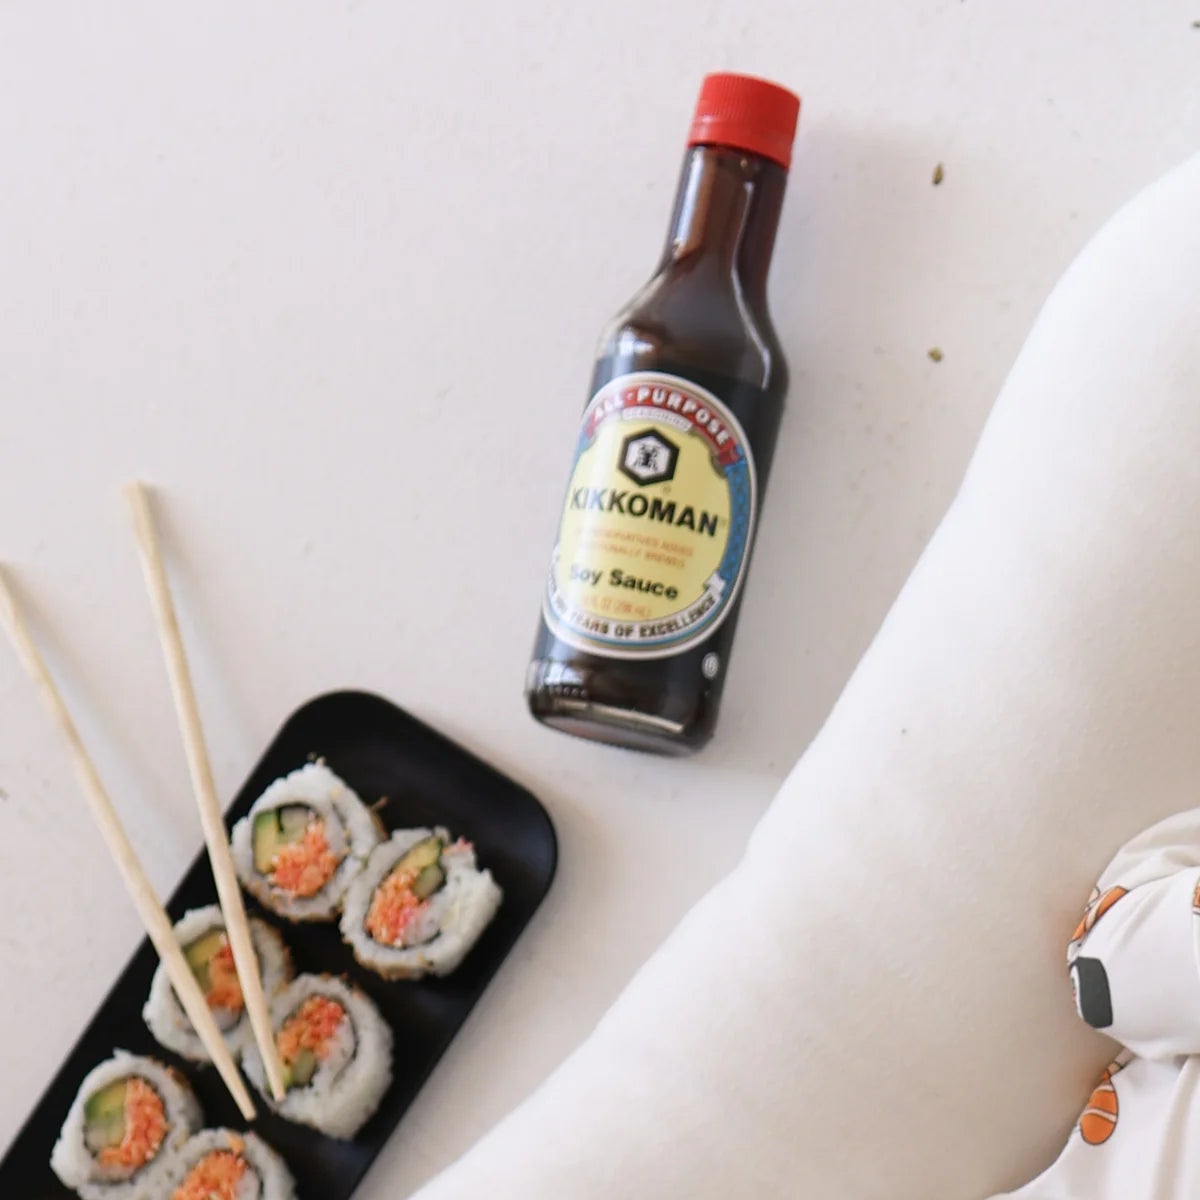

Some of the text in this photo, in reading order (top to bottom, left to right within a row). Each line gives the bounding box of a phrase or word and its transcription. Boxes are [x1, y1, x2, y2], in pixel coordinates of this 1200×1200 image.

[570, 487, 719, 537] KIKKOMAN
[570, 563, 679, 600] Soy Sauce
[614, 625, 634, 638] OF
[639, 594, 716, 637] EXCELLENCE
